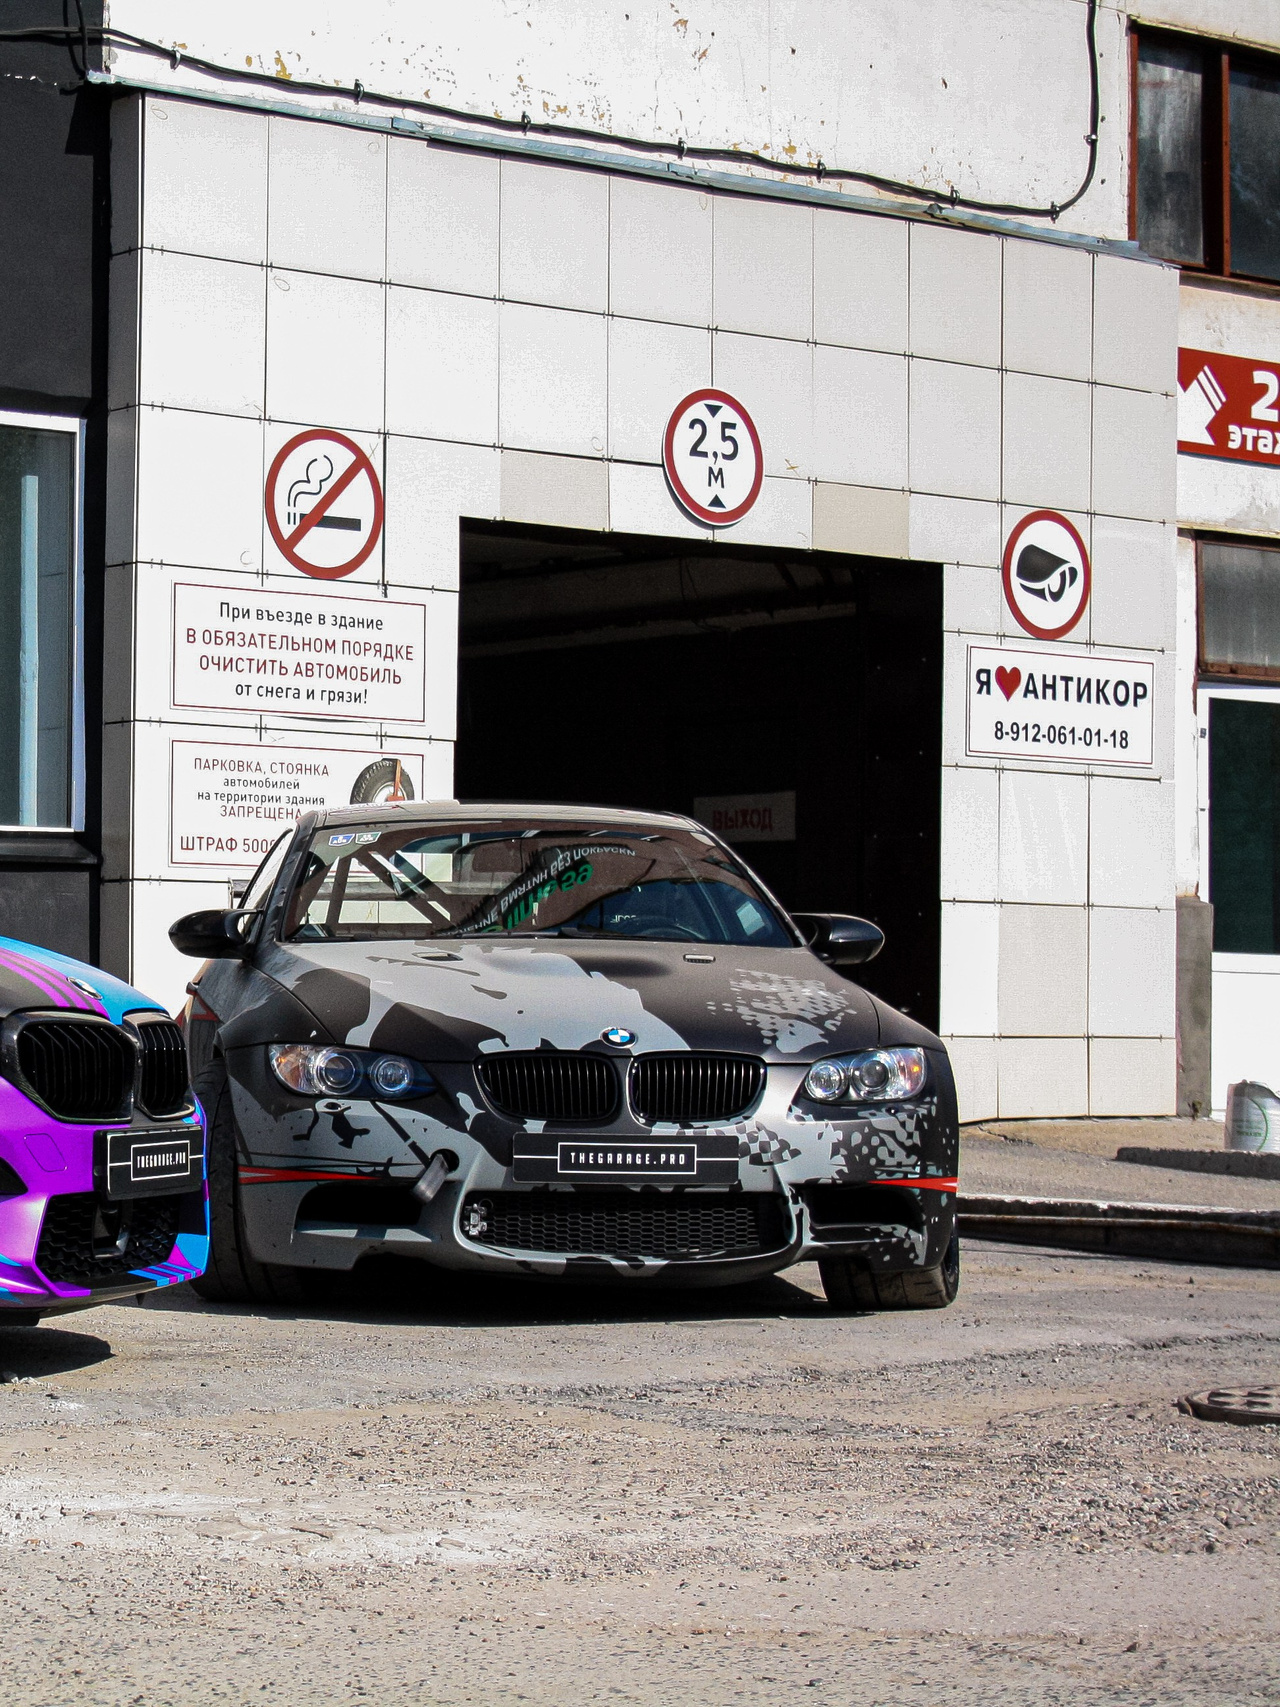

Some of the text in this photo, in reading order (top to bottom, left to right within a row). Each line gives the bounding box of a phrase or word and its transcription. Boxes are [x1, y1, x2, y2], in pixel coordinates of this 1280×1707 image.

[1251, 370, 1279, 422] 2
[688, 418, 739, 464] 2,5
[220, 602, 384, 630] При въезде в здание
[186, 628, 414, 661] В ОБЯЗАТЕЛЬНОМ ПОРЯДКЕ
[199, 655, 402, 684] ОЧИСТИТЬ АВТОМОБИЛЬ
[235, 683, 368, 705] от снега и грязи!
[975, 668, 1148, 707] Я АНТИКОР
[994, 720, 1129, 750] 8-912-061-01-18
[194, 758, 329, 776] ПАРКОВКА, СТОЯНКА
[223, 777, 300, 790] автомобилей
[197, 792, 325, 806] на территории здания
[220, 805, 302, 821] ЗАПРЕЩЕНА
[712, 807, 774, 832] ВЫХОД
[180, 836, 238, 852] ШТРАФ
[570, 1152, 685, 1165] THEGARAGE.PRO
